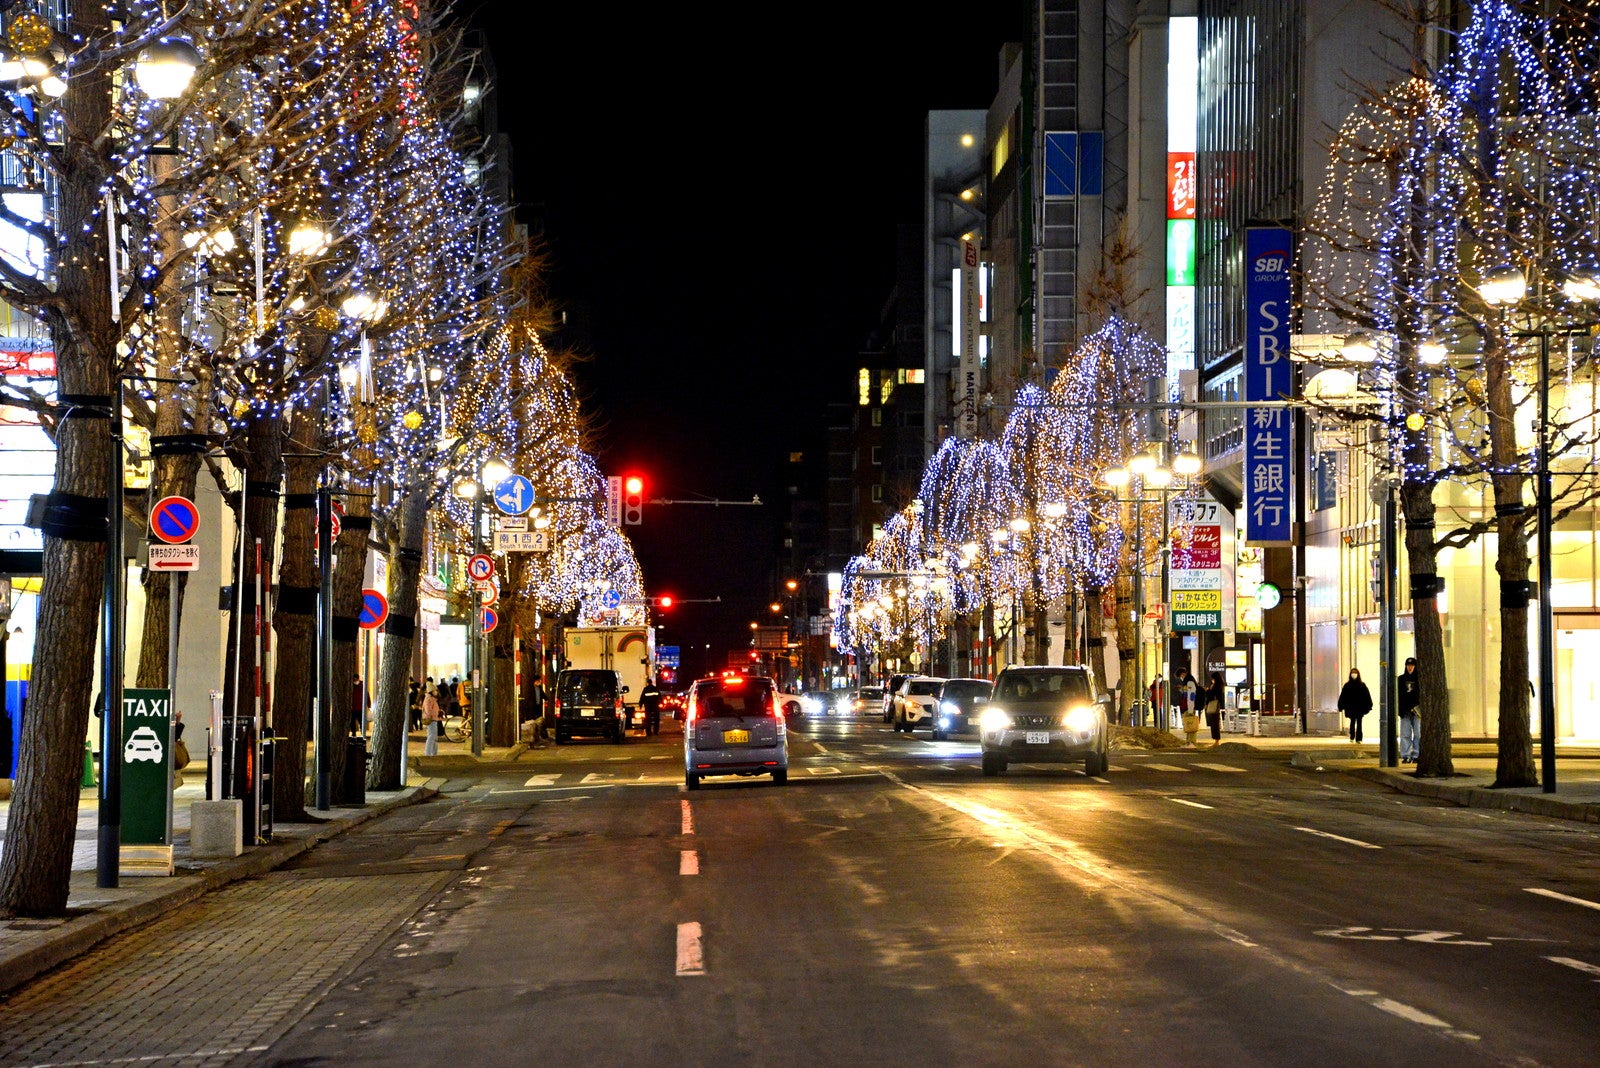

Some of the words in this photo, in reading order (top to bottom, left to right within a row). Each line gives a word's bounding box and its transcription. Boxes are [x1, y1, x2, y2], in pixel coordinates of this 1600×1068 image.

[965, 242, 977, 267] TKP
[1254, 258, 1283, 272] SBI
[1254, 274, 1284, 282] GROUP
[966, 372, 975, 422] MARUZEN
[1186, 592, 1218, 602] かなざわ
[1175, 602, 1218, 610] 内科クリニック
[1175, 613, 1218, 626] 朝田歯科
[123, 698, 168, 717] TAXI
